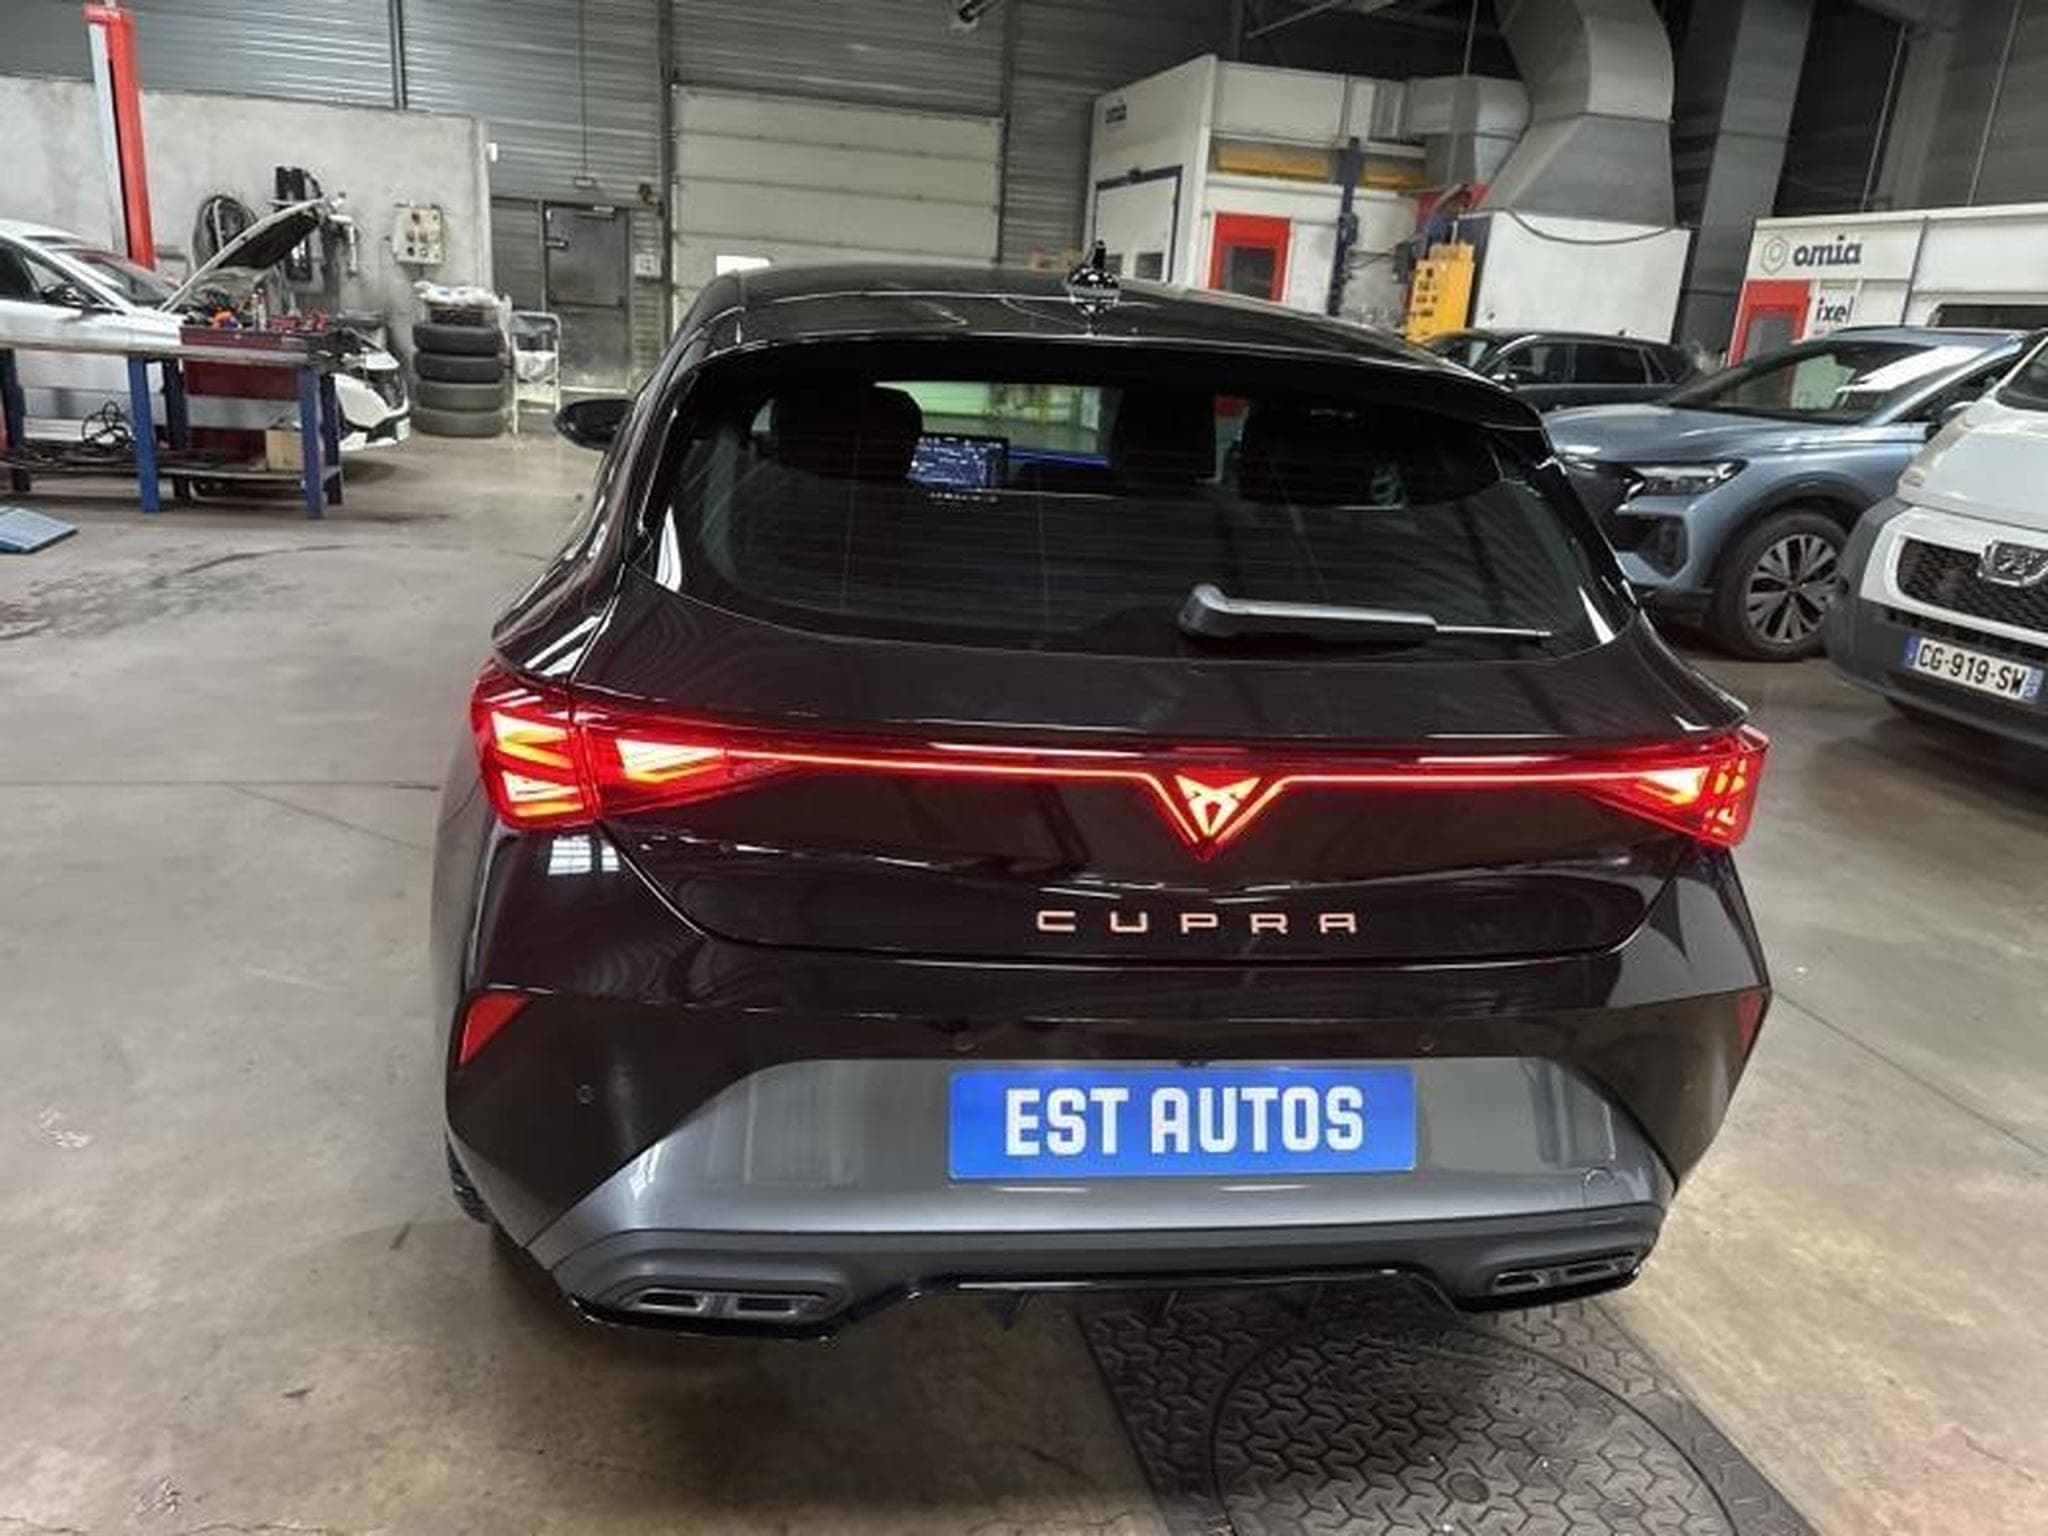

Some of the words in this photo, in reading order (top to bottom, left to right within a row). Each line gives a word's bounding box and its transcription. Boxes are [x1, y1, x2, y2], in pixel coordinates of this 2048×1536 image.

[1793, 235, 1862, 267] omia
[1919, 644, 2026, 696] CG-919-SW
[1036, 910, 1357, 935] CUPRA
[1006, 1087, 1129, 1156] EST
[1151, 1085, 1364, 1154] AUTOS
